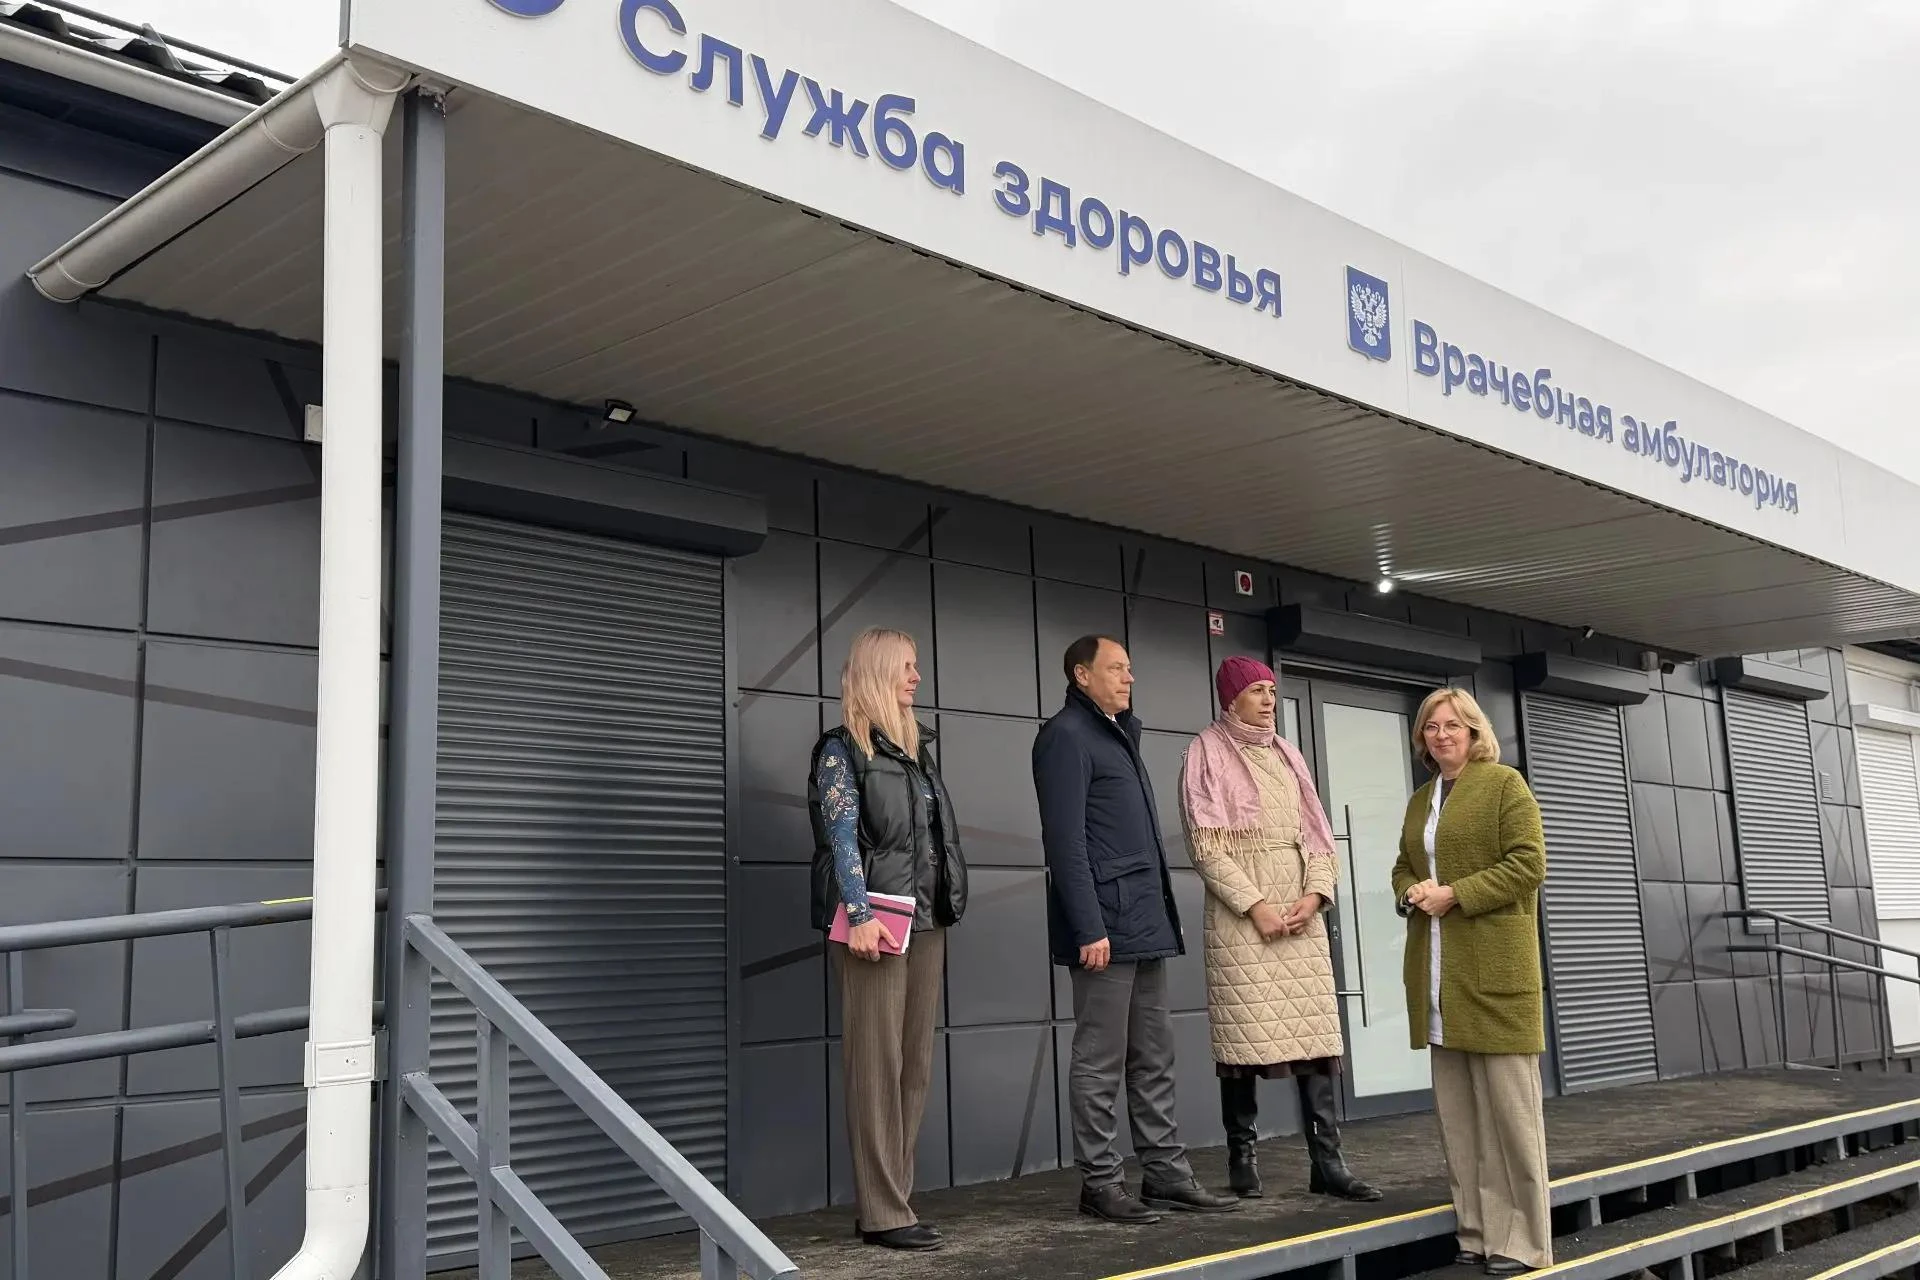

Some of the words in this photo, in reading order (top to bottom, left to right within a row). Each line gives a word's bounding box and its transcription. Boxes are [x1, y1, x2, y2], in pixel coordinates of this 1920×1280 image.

[616, 0, 965, 196] Служба
[993, 161, 1283, 317] здоровья
[1410, 318, 1614, 442] Врачебная
[1622, 412, 1799, 514] амбулатория
